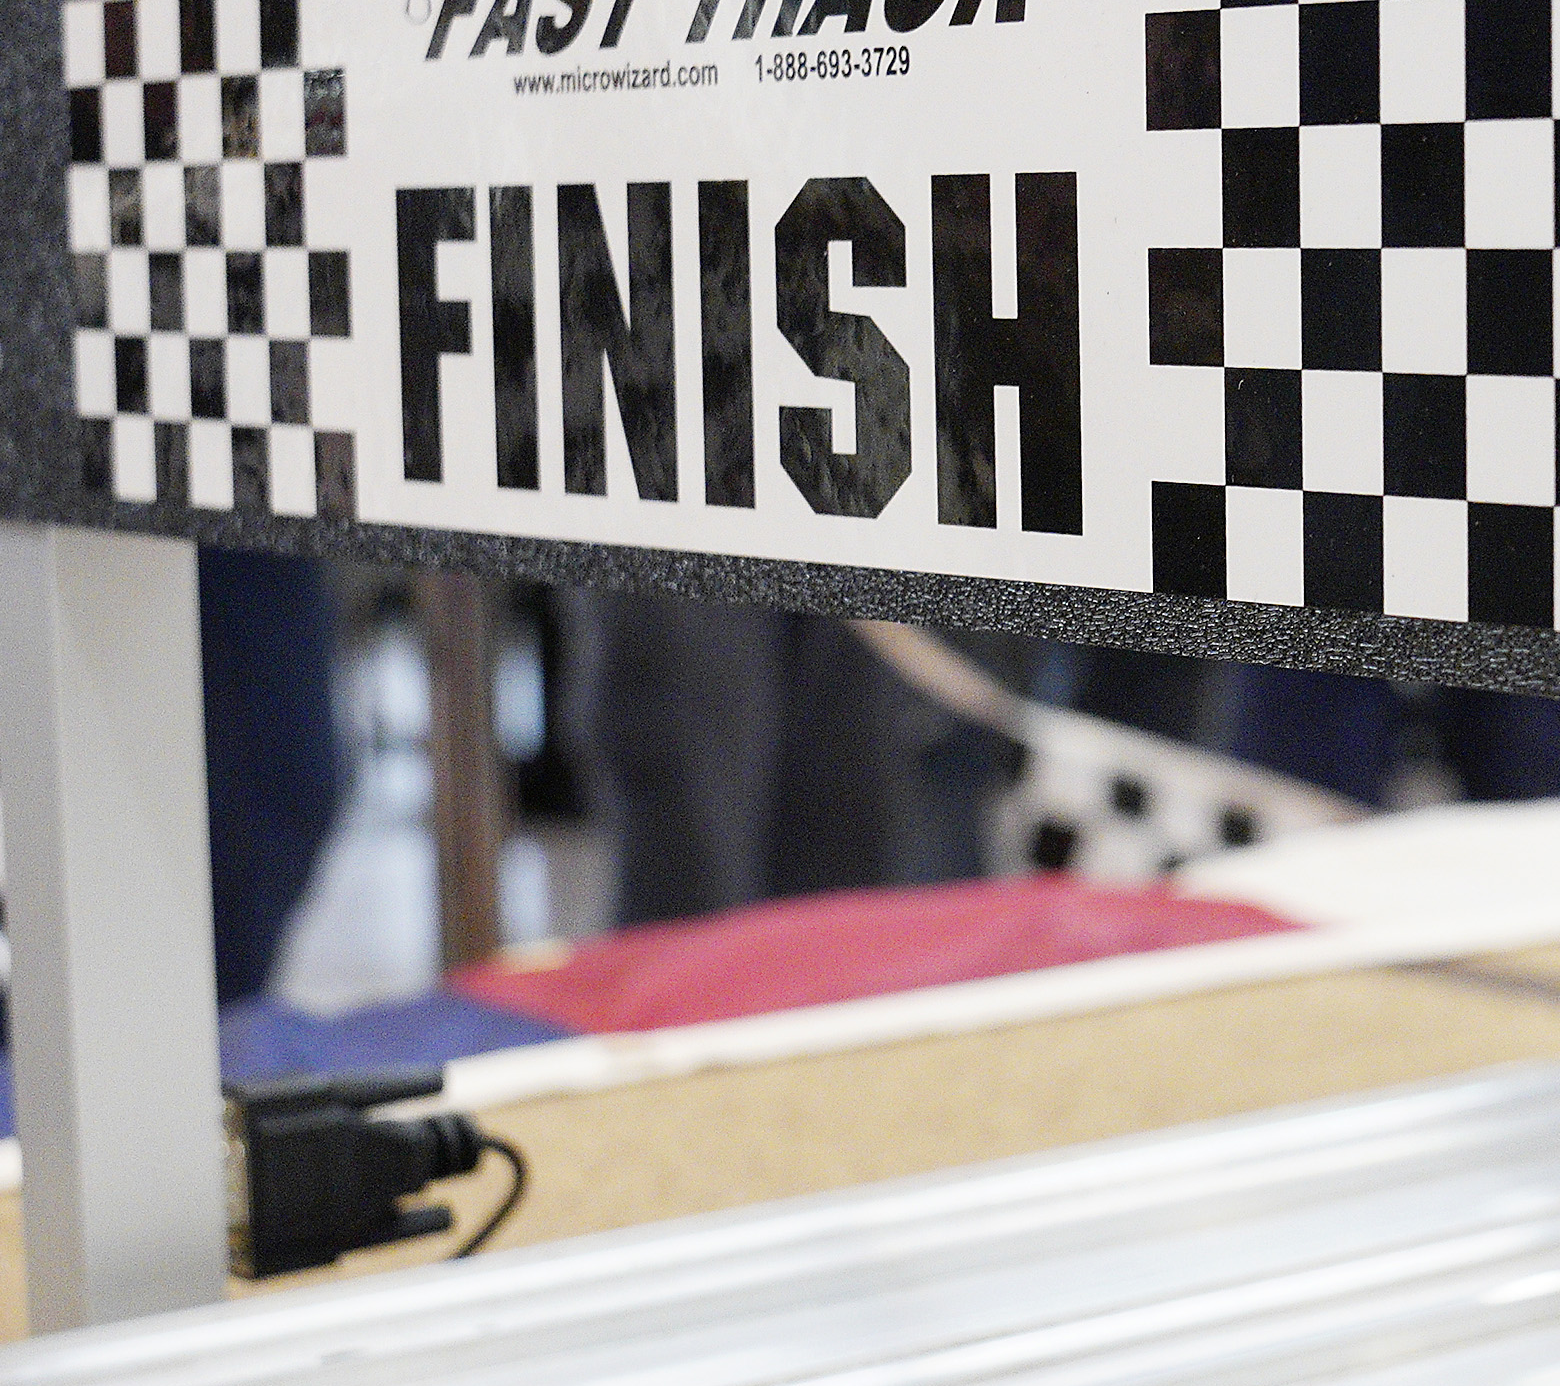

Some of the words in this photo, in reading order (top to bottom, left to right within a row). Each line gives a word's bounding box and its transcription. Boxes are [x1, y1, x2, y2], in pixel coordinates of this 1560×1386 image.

[513, 60, 719, 96] www.microwizard.com
[754, 45, 911, 83] 1-888-693-3729
[395, 171, 1084, 537] FINISH
